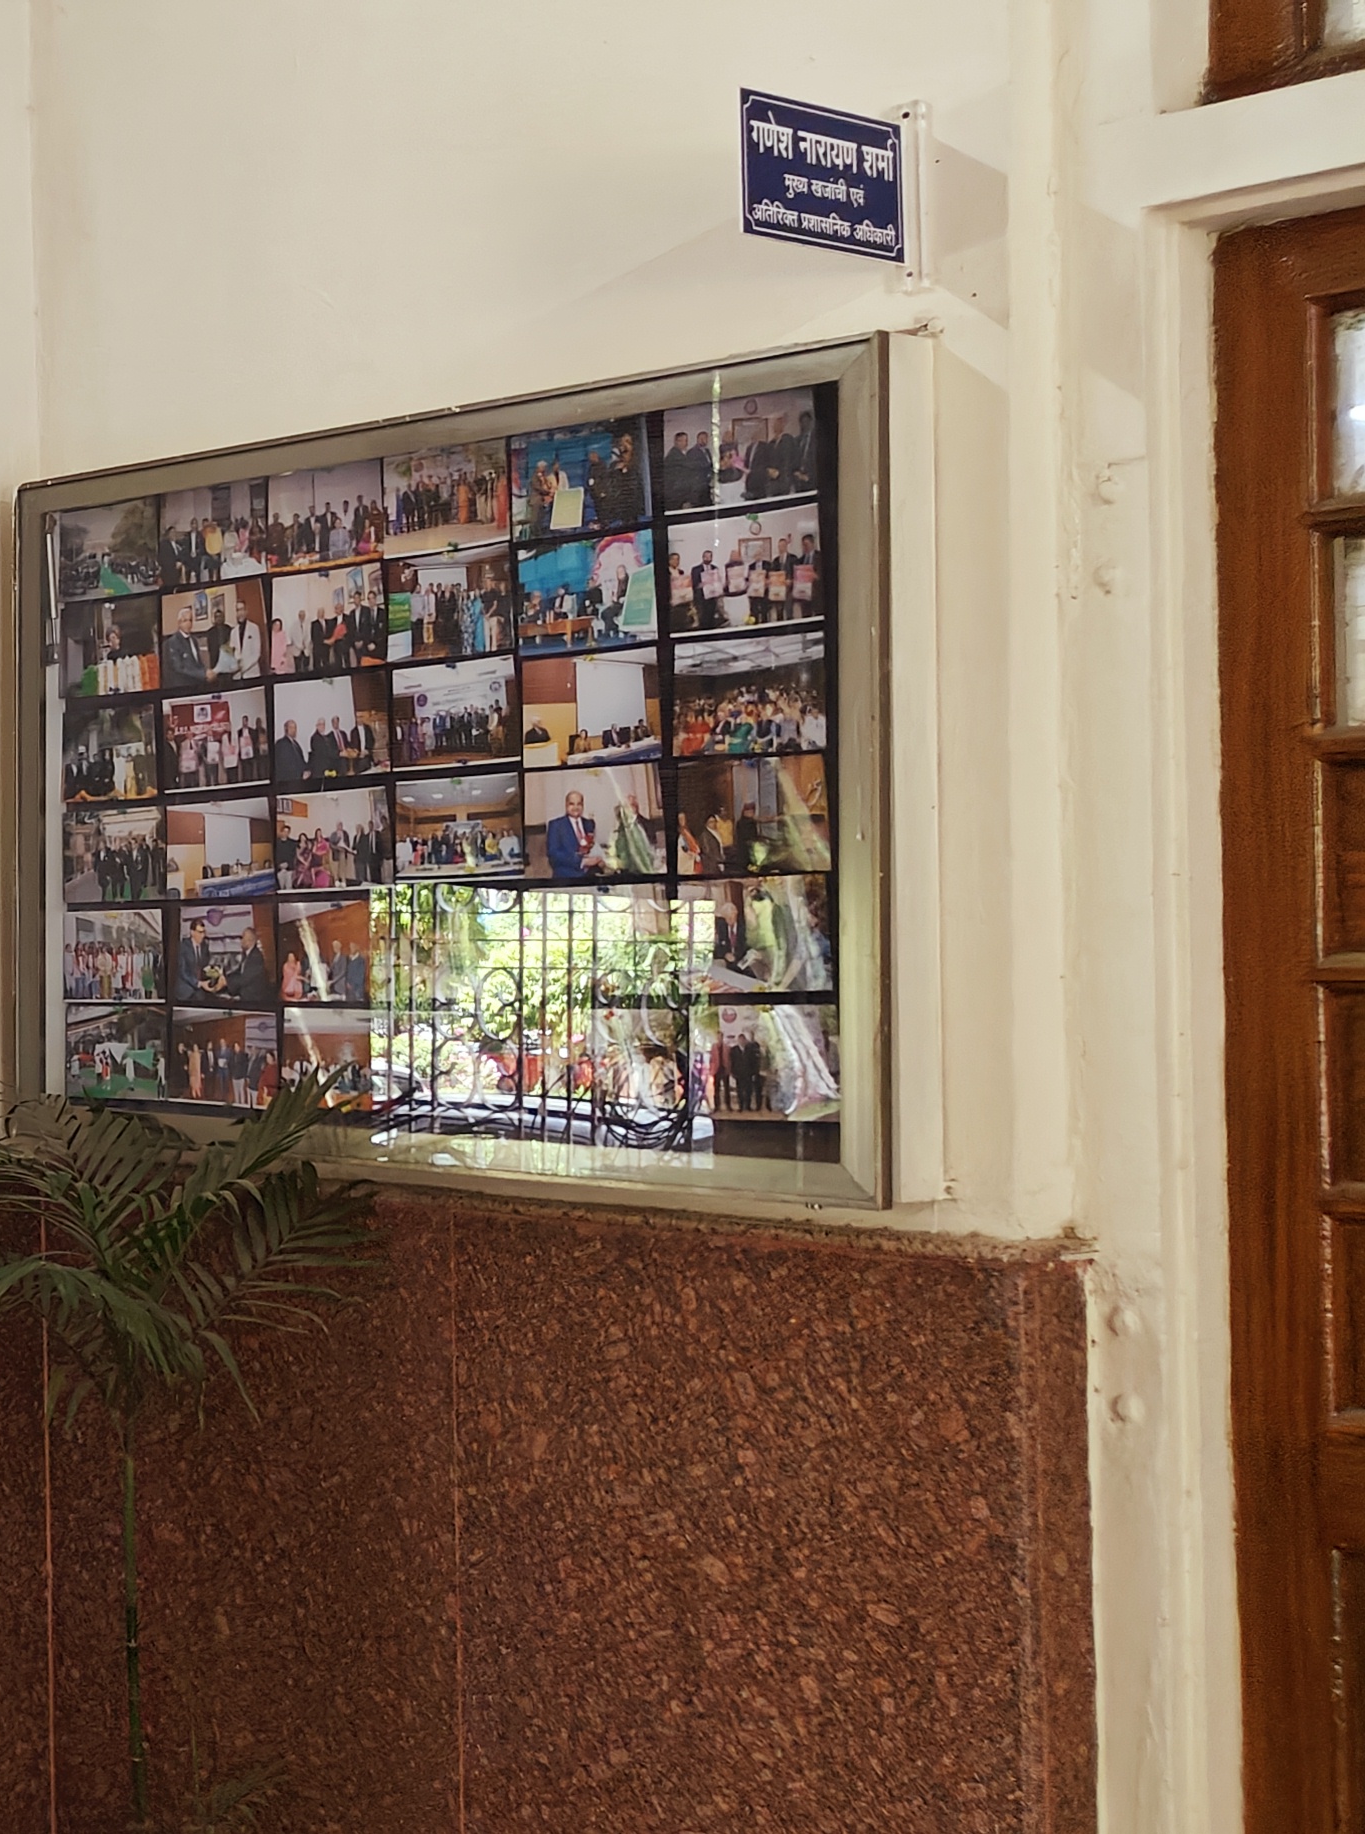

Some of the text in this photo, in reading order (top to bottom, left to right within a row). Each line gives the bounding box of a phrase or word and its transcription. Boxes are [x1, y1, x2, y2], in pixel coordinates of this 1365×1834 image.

[749, 110, 894, 182] गणेश नारायण शर्मा
[783, 173, 865, 208] मुख्य खजांची एवं
[751, 199, 896, 247] अतिरिक्त प्रशासनिक अधिकारी
